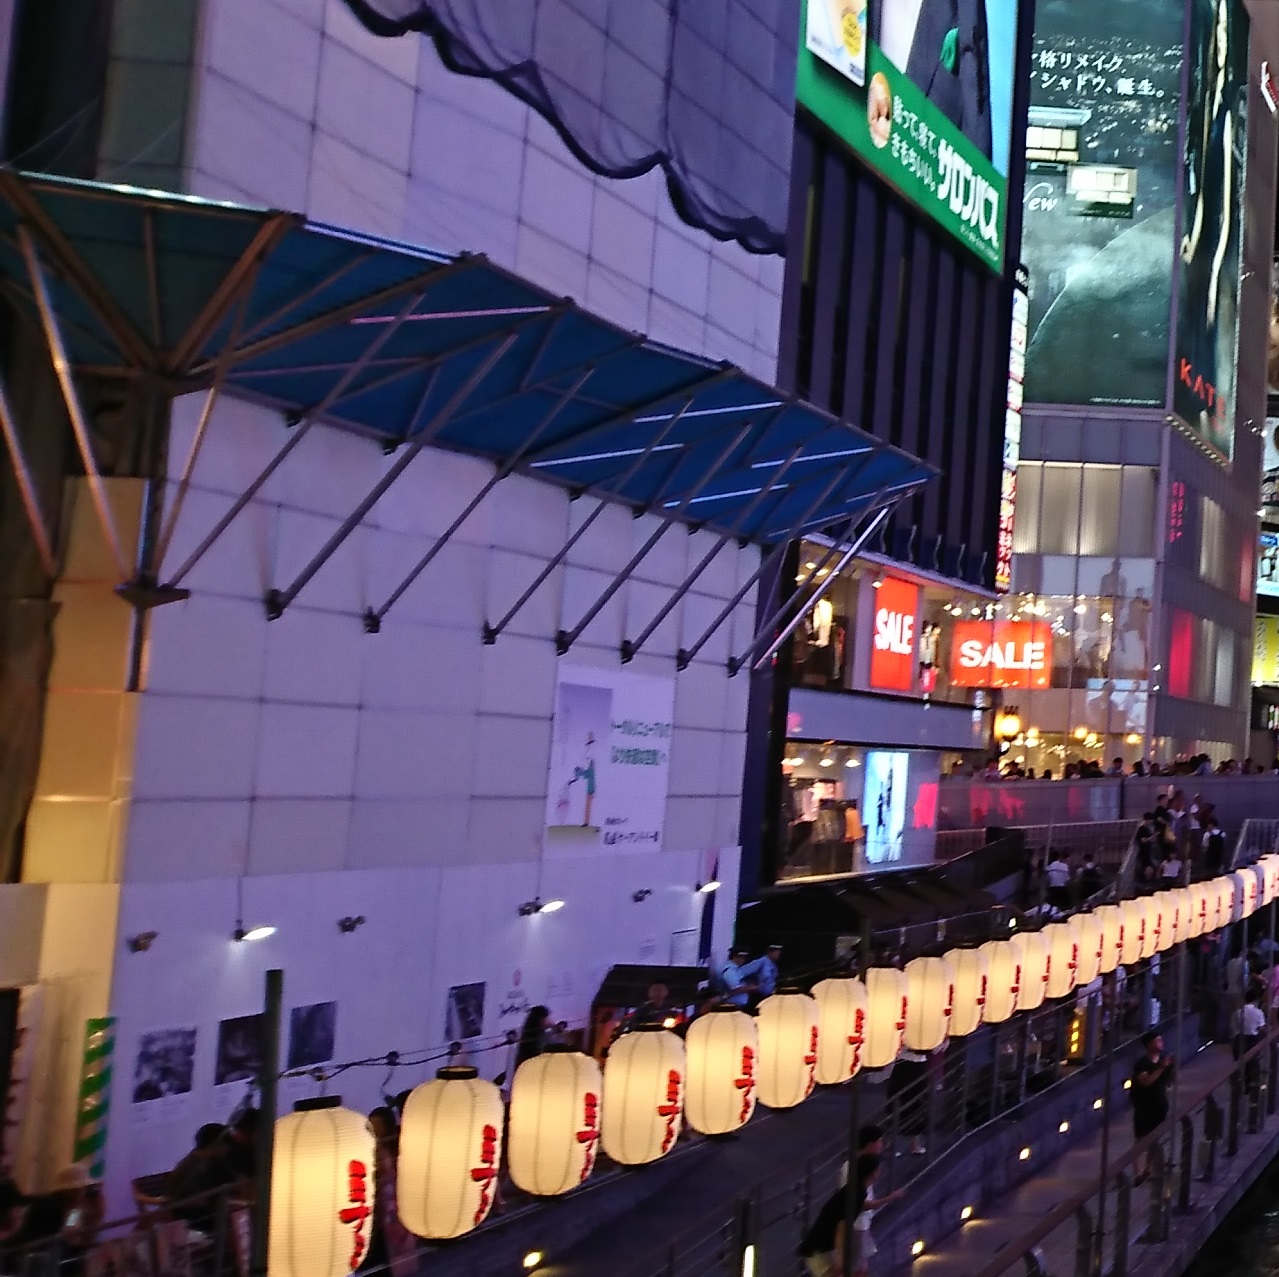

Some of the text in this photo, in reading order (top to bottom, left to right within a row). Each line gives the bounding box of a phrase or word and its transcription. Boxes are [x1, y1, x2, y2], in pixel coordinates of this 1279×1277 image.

[936, 138, 1000, 250] サロンパス
[874, 606, 914, 657] SALE
[958, 640, 1046, 671] SALE
